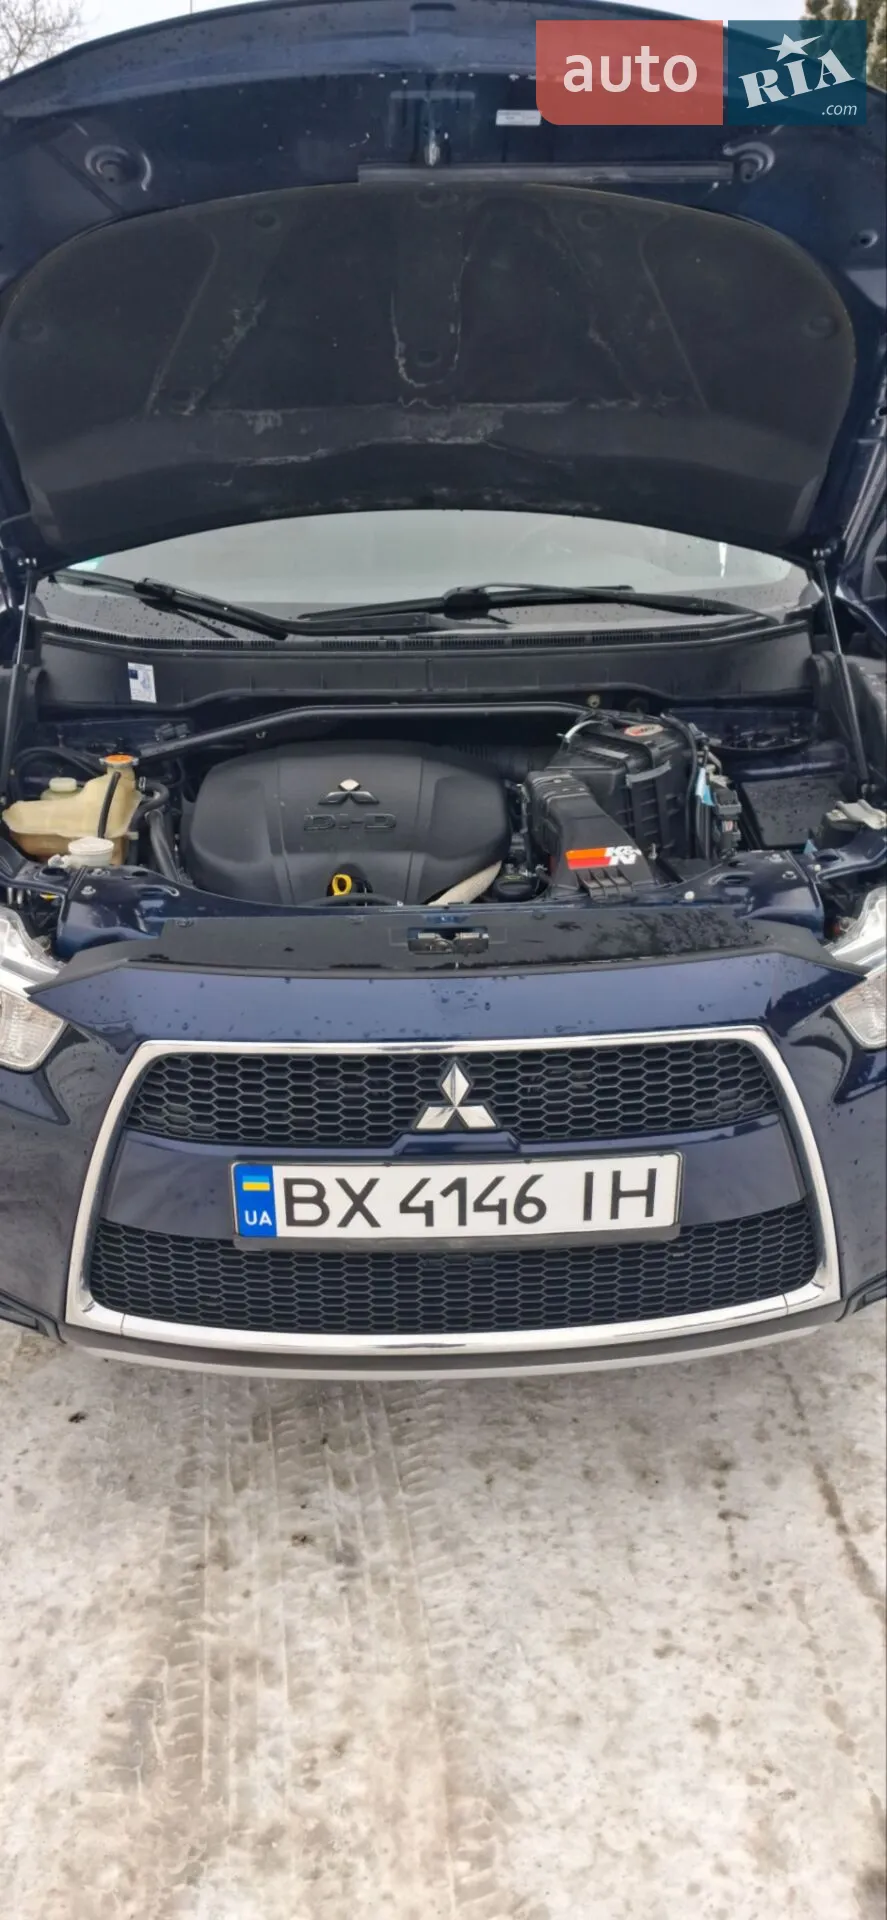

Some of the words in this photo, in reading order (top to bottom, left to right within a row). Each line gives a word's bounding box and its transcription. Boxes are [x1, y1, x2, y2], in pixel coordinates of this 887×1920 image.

[283, 1178, 381, 1227] BX
[399, 1174, 547, 1227] 4146
[582, 1168, 657, 1221] IH
[244, 1210, 272, 1227] UA
